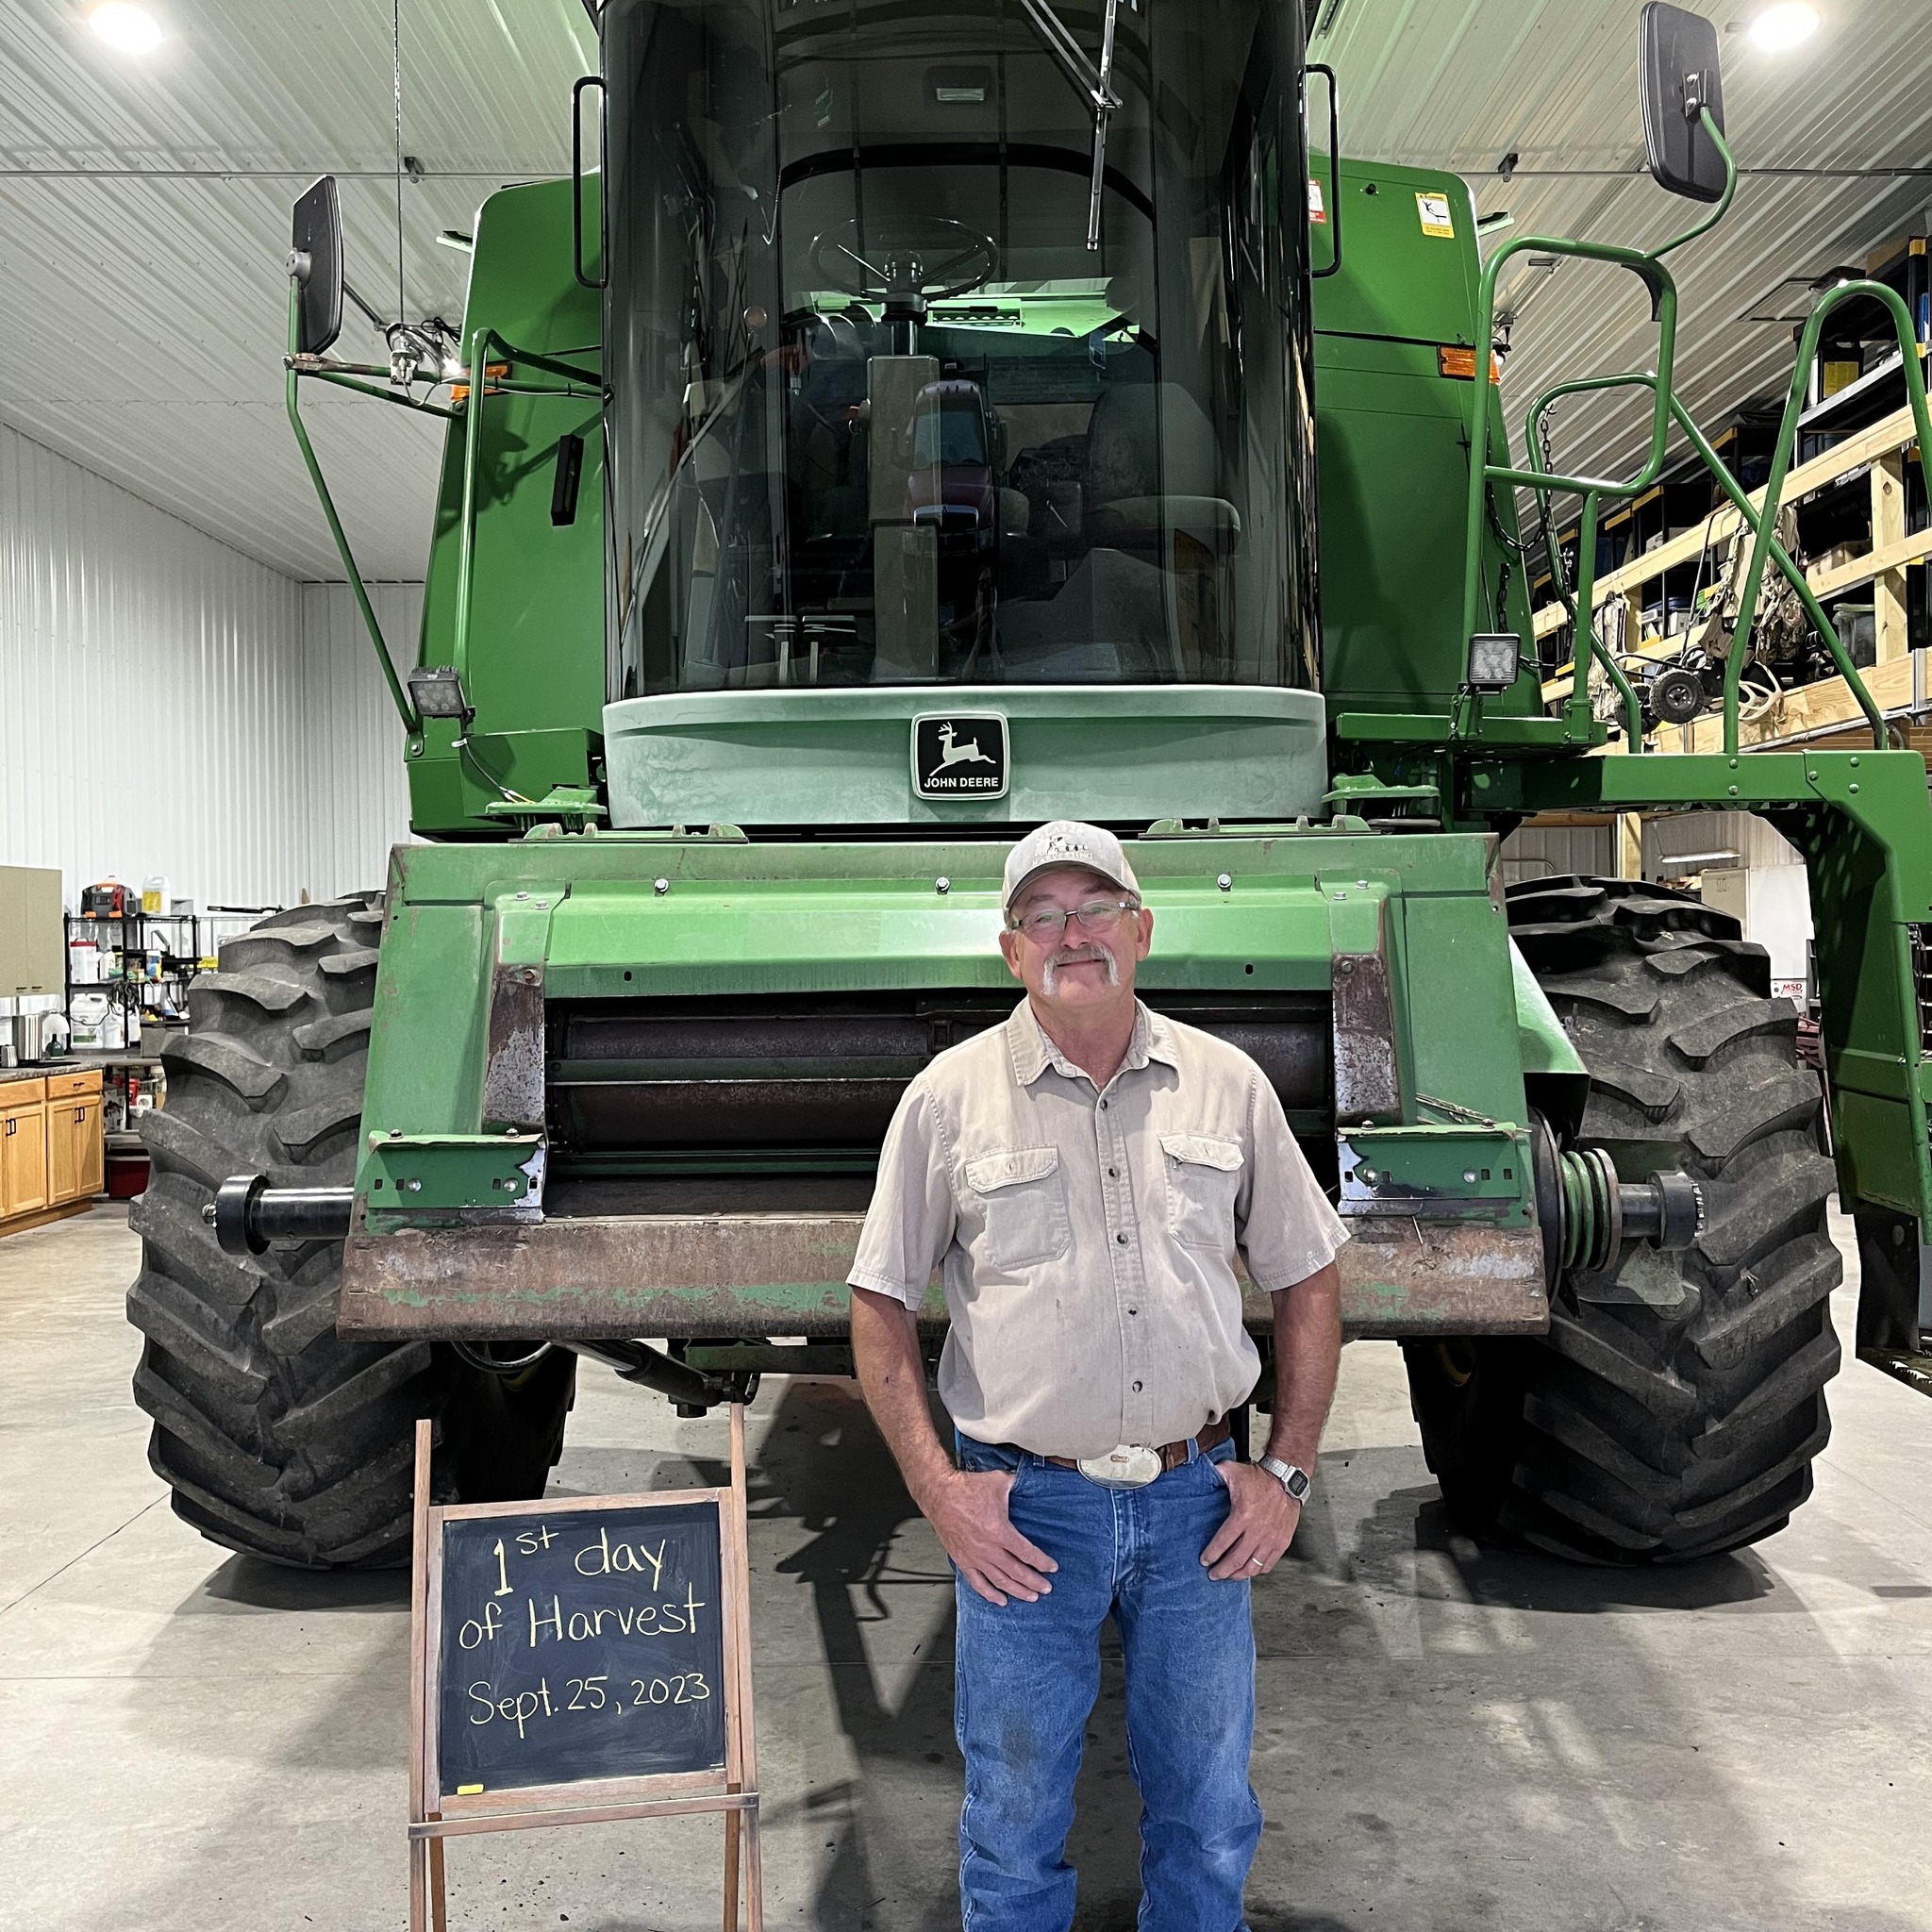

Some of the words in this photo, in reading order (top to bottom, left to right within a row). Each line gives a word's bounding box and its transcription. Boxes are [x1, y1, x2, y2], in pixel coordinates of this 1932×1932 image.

[924, 777, 957, 788] JOHN
[959, 777, 999, 788] DEERE
[1032, 851, 1093, 867] HARVESTING
[493, 1524, 559, 1596] 1st
[574, 1526, 666, 1592] day
[458, 1601, 503, 1649] of
[528, 1581, 706, 1648] Harvest
[468, 1677, 559, 1740] Sept.
[566, 1675, 623, 1715] 25,
[630, 1673, 710, 1706] 2023
